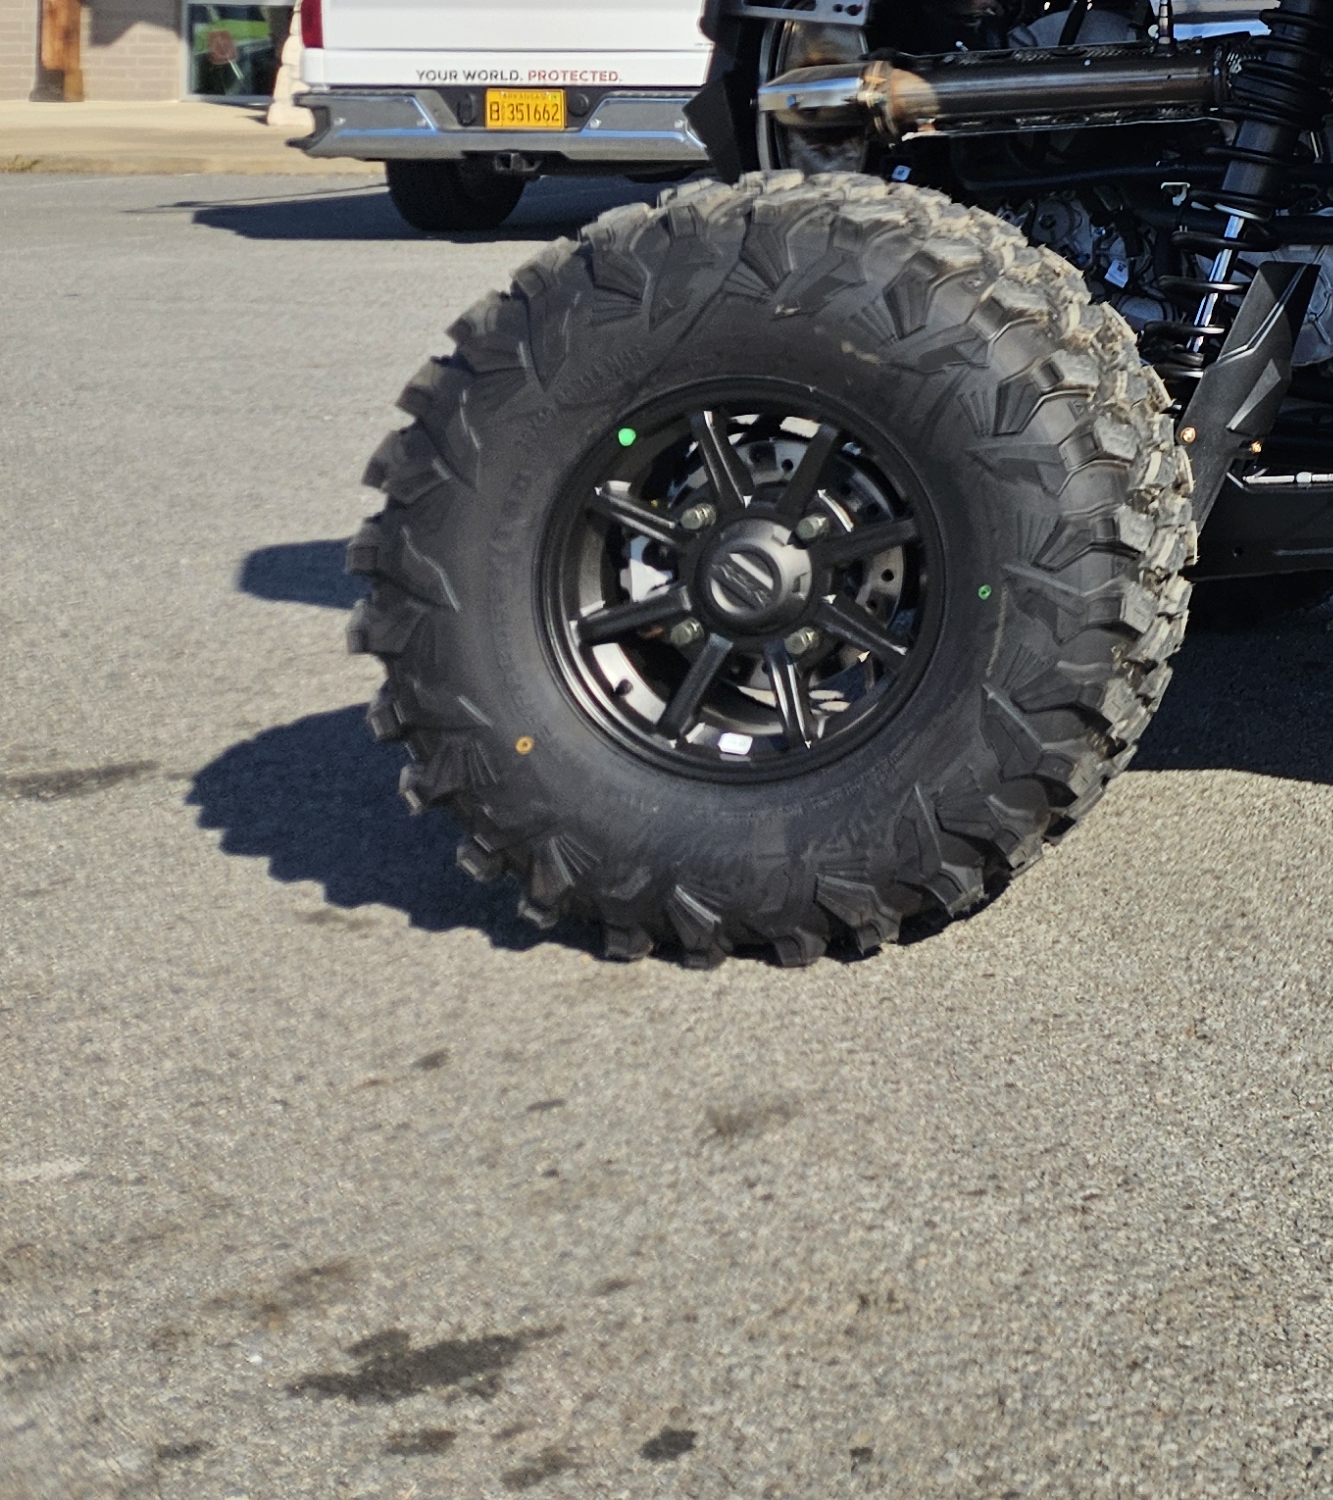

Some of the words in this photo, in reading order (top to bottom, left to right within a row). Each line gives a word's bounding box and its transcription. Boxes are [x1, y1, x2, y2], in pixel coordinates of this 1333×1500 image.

[416, 69, 458, 82] YOUR
[462, 69, 524, 82] WORLD.
[528, 69, 623, 82] PROTECTED.
[507, 102, 560, 122] 351662
